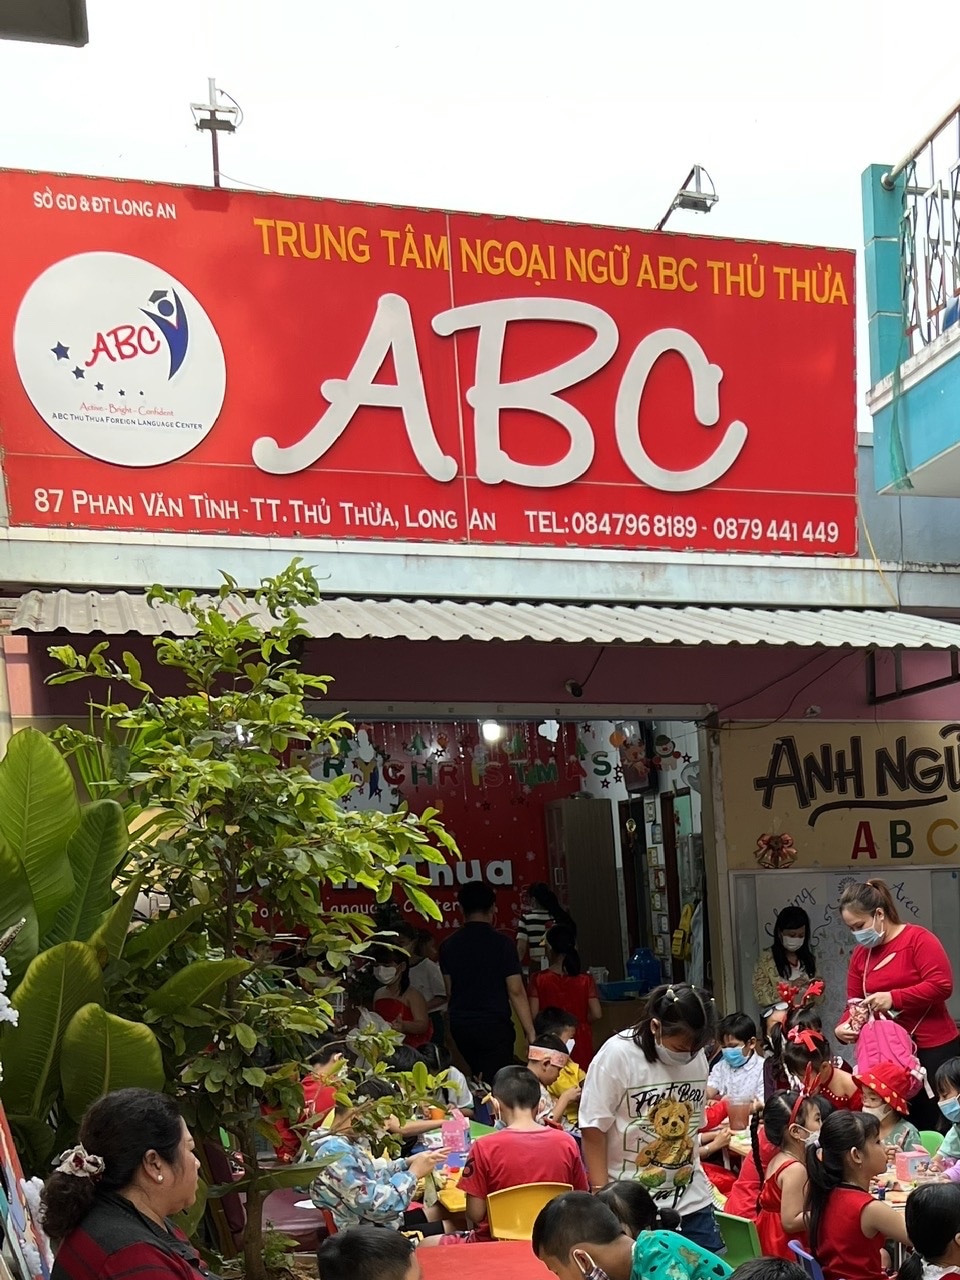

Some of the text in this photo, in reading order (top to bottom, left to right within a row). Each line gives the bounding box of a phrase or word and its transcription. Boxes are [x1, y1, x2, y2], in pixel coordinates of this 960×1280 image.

[56, 193, 77, 211] GD
[92, 196, 111, 213] ĐT
[113, 199, 153, 217] LONG
[156, 202, 176, 219] AN
[253, 217, 848, 305] TRUNG TÂM NGOẠI NGỮ ABC THỦ THỪA
[85, 325, 160, 367] ABC
[109, 403, 132, 415] Bright
[138, 405, 174, 416] Confident
[252, 293, 748, 493] ABC
[52, 412, 69, 420] ABC
[34, 487, 64, 513] 87
[753, 735, 865, 809] ANH
